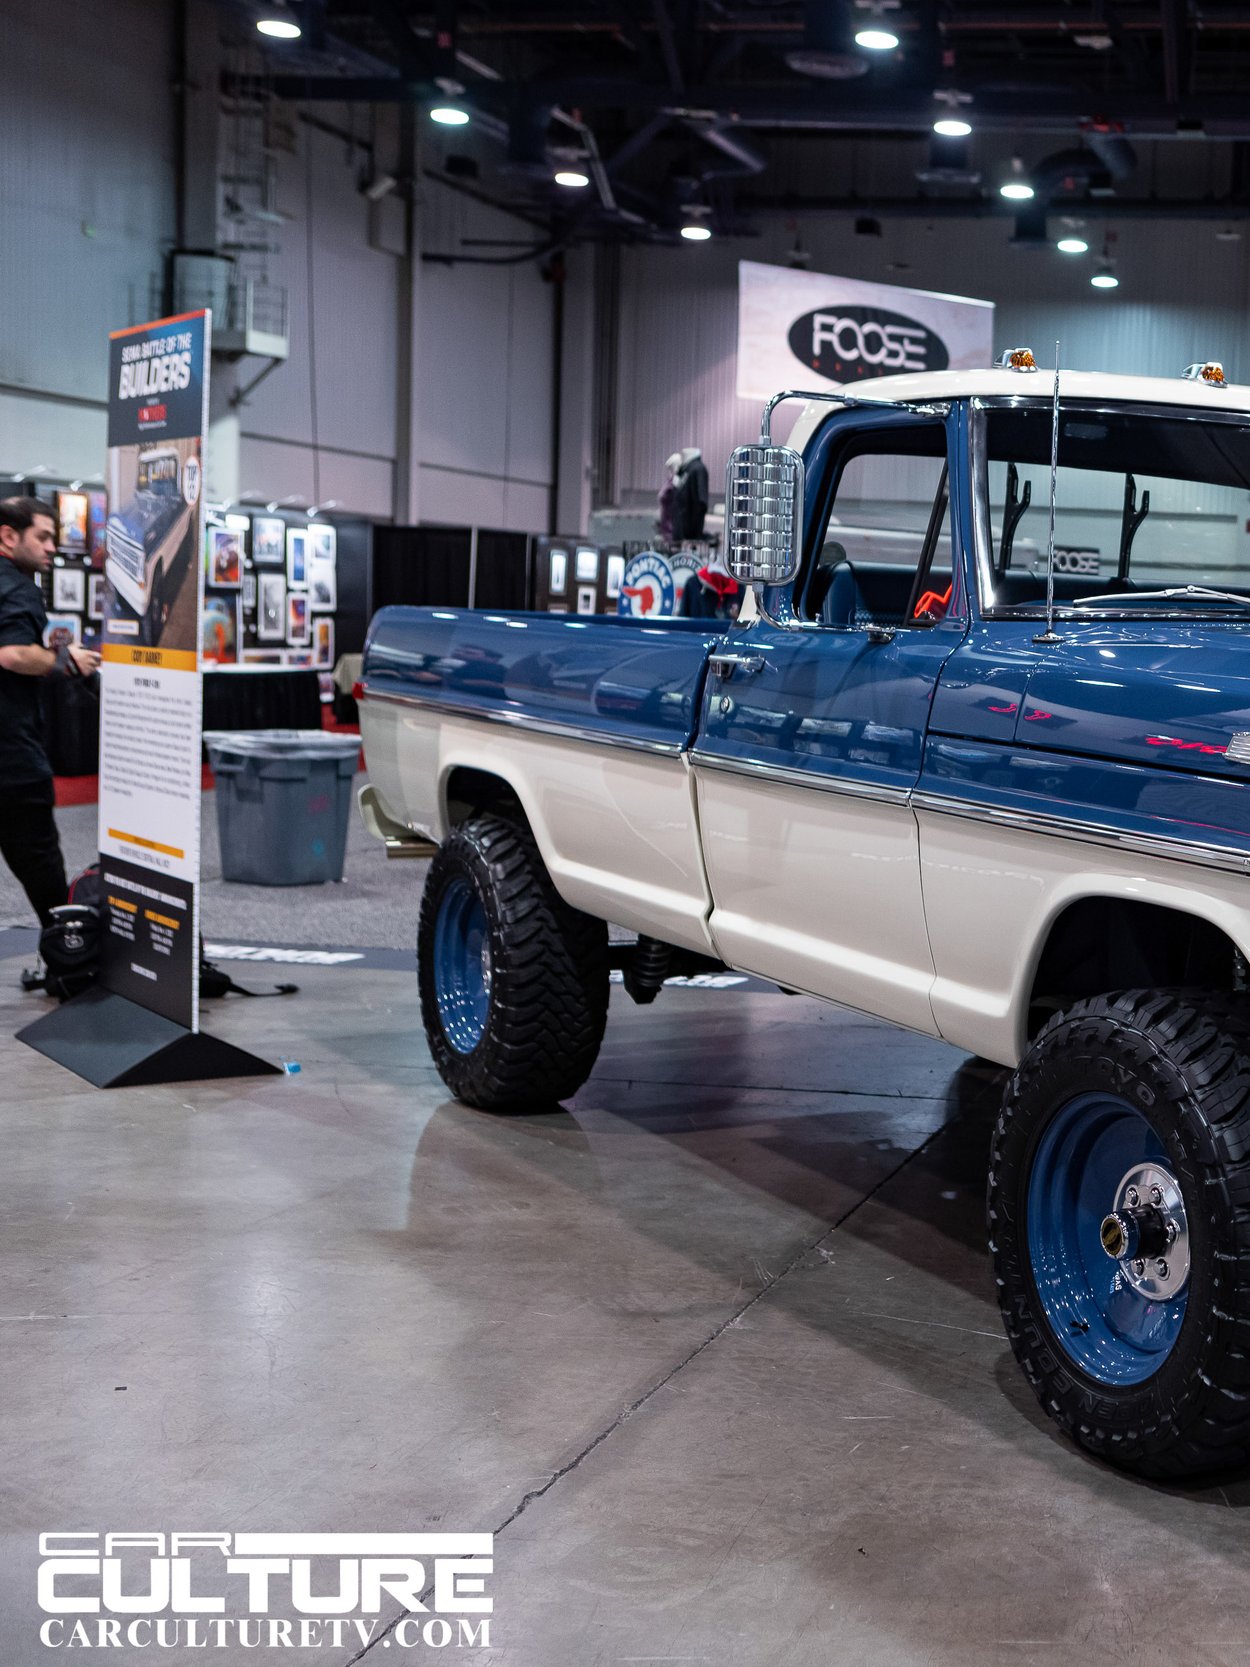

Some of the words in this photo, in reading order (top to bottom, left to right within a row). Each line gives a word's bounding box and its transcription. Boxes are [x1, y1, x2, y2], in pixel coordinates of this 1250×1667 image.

[177, 332, 193, 349] THE
[812, 313, 926, 370] FOOSE
[119, 351, 192, 400] BUILDERS
[625, 558, 671, 588] PONTIAC
